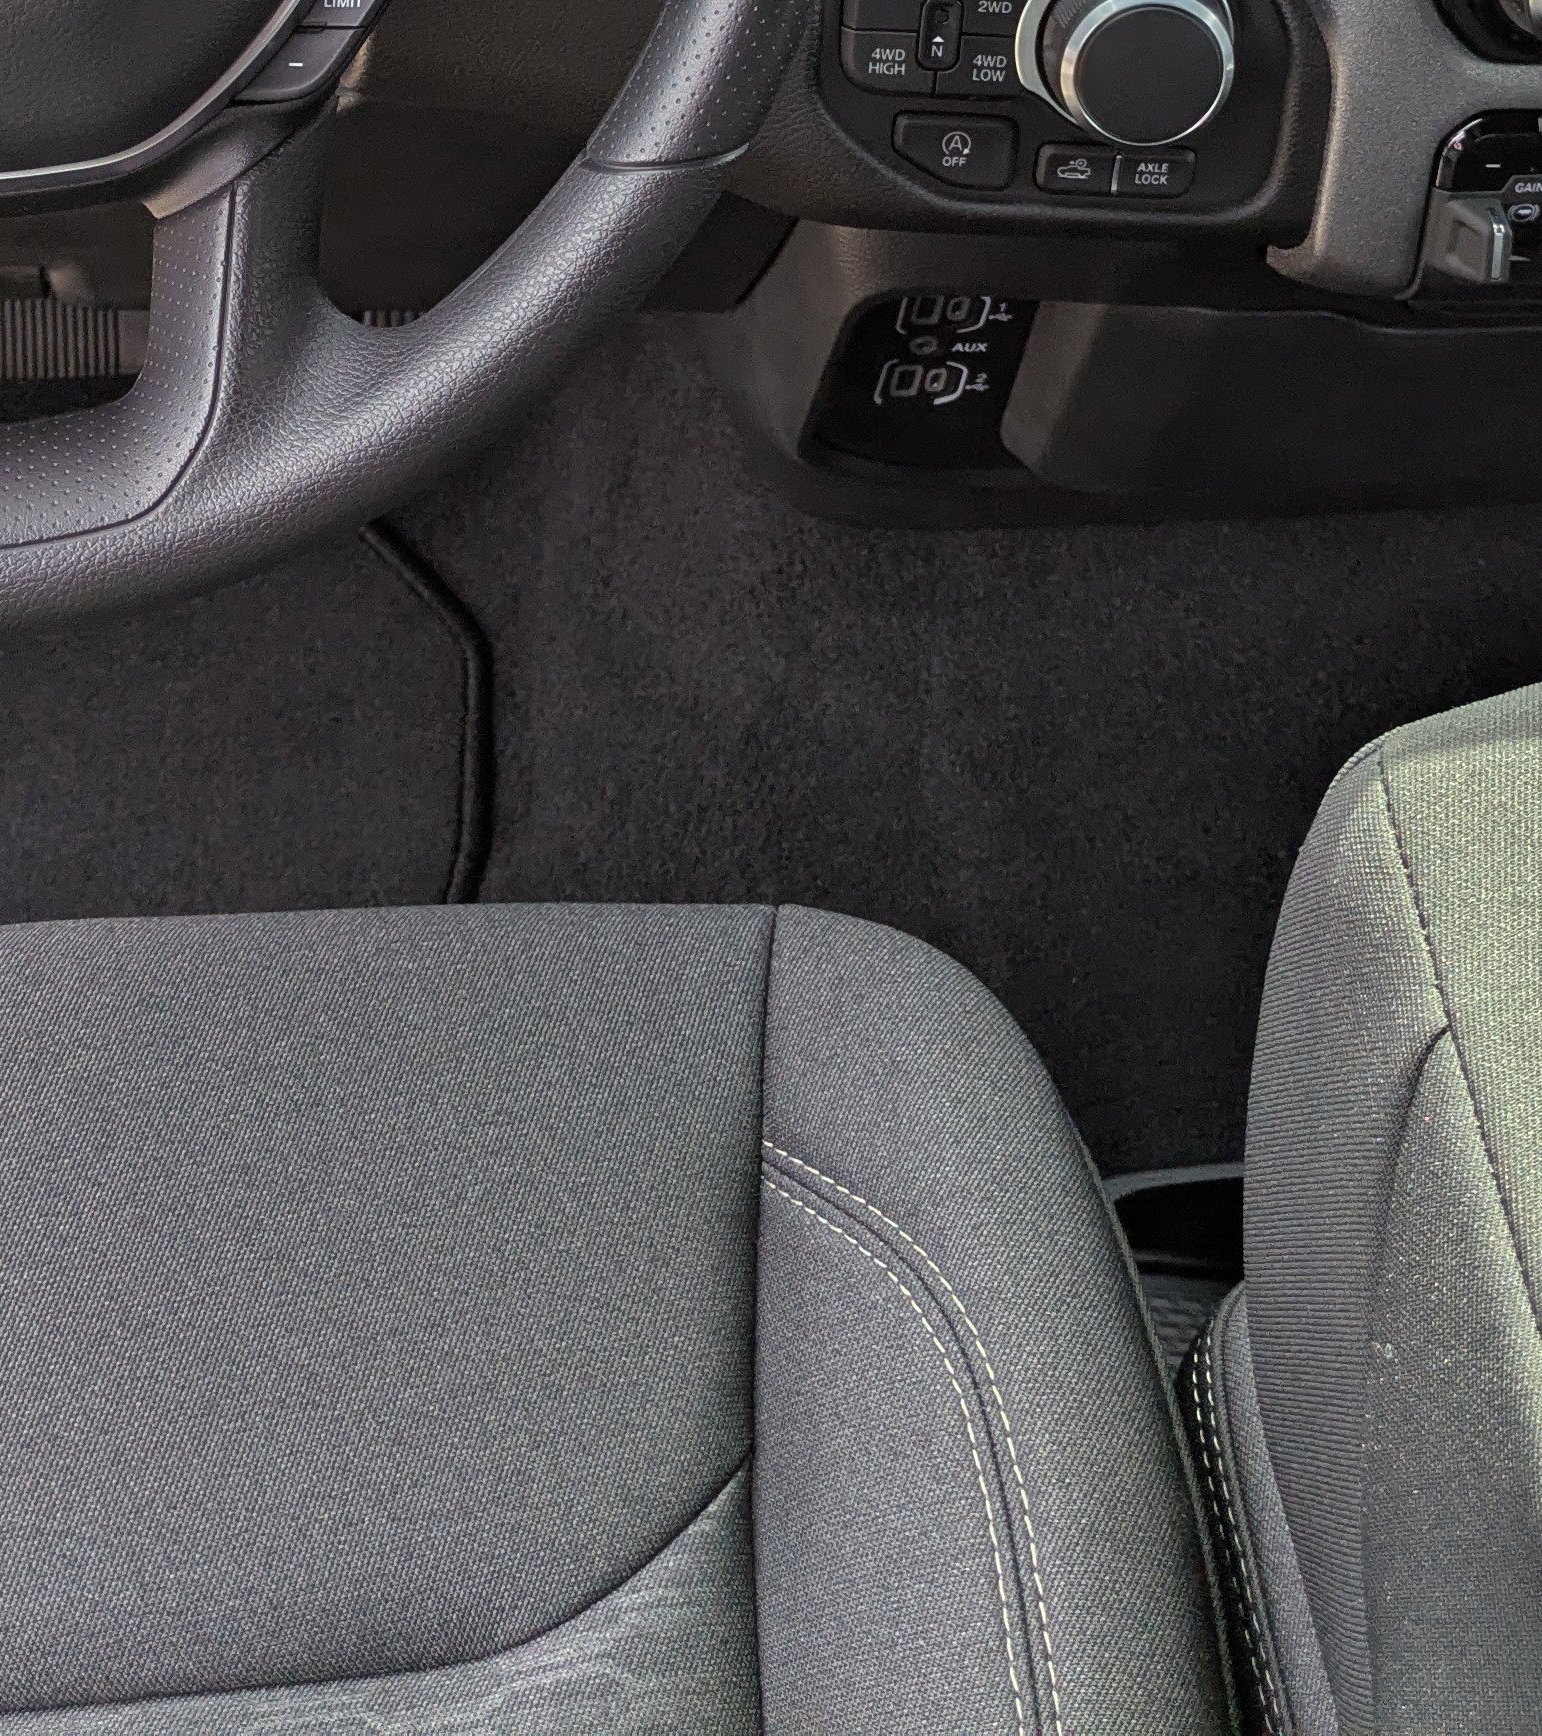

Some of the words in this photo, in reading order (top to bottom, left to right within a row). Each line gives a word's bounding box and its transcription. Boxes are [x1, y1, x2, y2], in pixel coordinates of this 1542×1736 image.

[978, 0, 1012, 14] 2WD
[871, 47, 906, 61] 4WD
[931, 45, 942, 57] N
[973, 54, 1007, 68] 4WD
[868, 60, 906, 76] HIGH
[972, 68, 1006, 83] LOW
[942, 155, 967, 167] OFF
[1137, 163, 1168, 173] AXLE
[1135, 174, 1168, 185] LOCK
[952, 343, 988, 352] AUX
